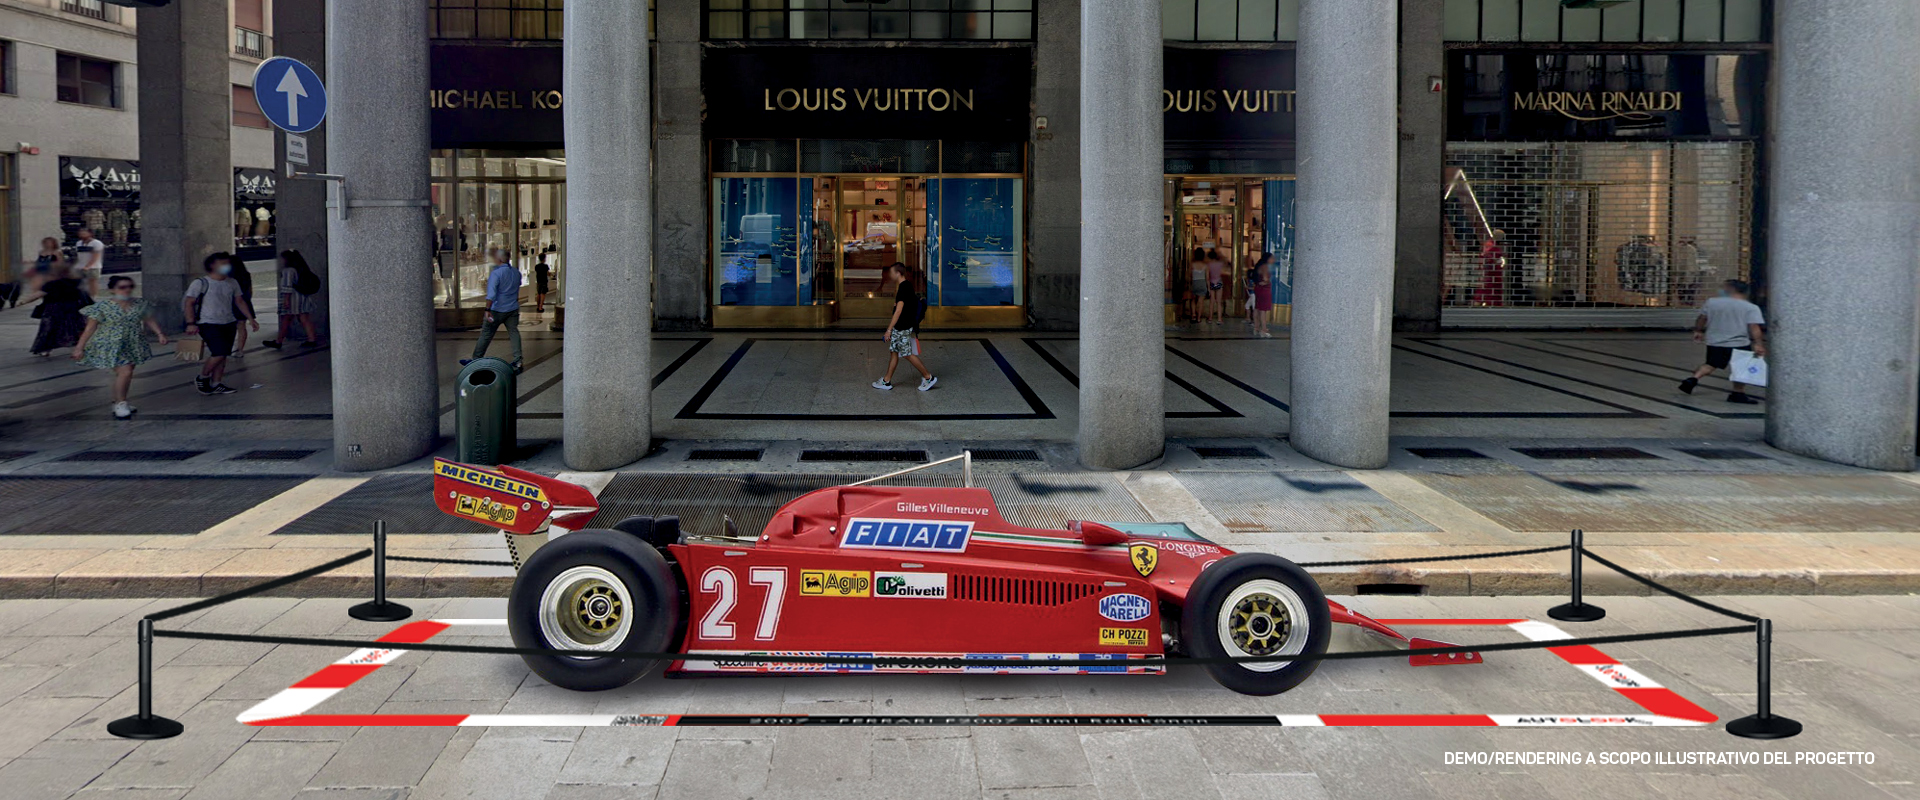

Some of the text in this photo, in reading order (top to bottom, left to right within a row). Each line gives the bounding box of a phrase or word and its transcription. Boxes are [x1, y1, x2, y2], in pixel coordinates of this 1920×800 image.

[765, 87, 973, 111] LOUIS VUITTON
[1222, 89, 1296, 113] VUITT
[1514, 91, 1681, 116] MARINA RINALDI
[441, 464, 540, 499] MICHELIN
[477, 500, 516, 522] Agip
[896, 502, 990, 516] Gilles Villeneuve
[854, 524, 963, 546] FIAT
[1158, 541, 1221, 554] LONGINES
[825, 573, 869, 595] Agip
[898, 585, 945, 597] olivetti
[699, 566, 788, 641] 27
[1101, 595, 1149, 612] MAGNETI
[1101, 603, 1149, 620] MARELLI
[1102, 629, 1146, 640] CH POZZI
[1028, 717, 1078, 725] Kimi
